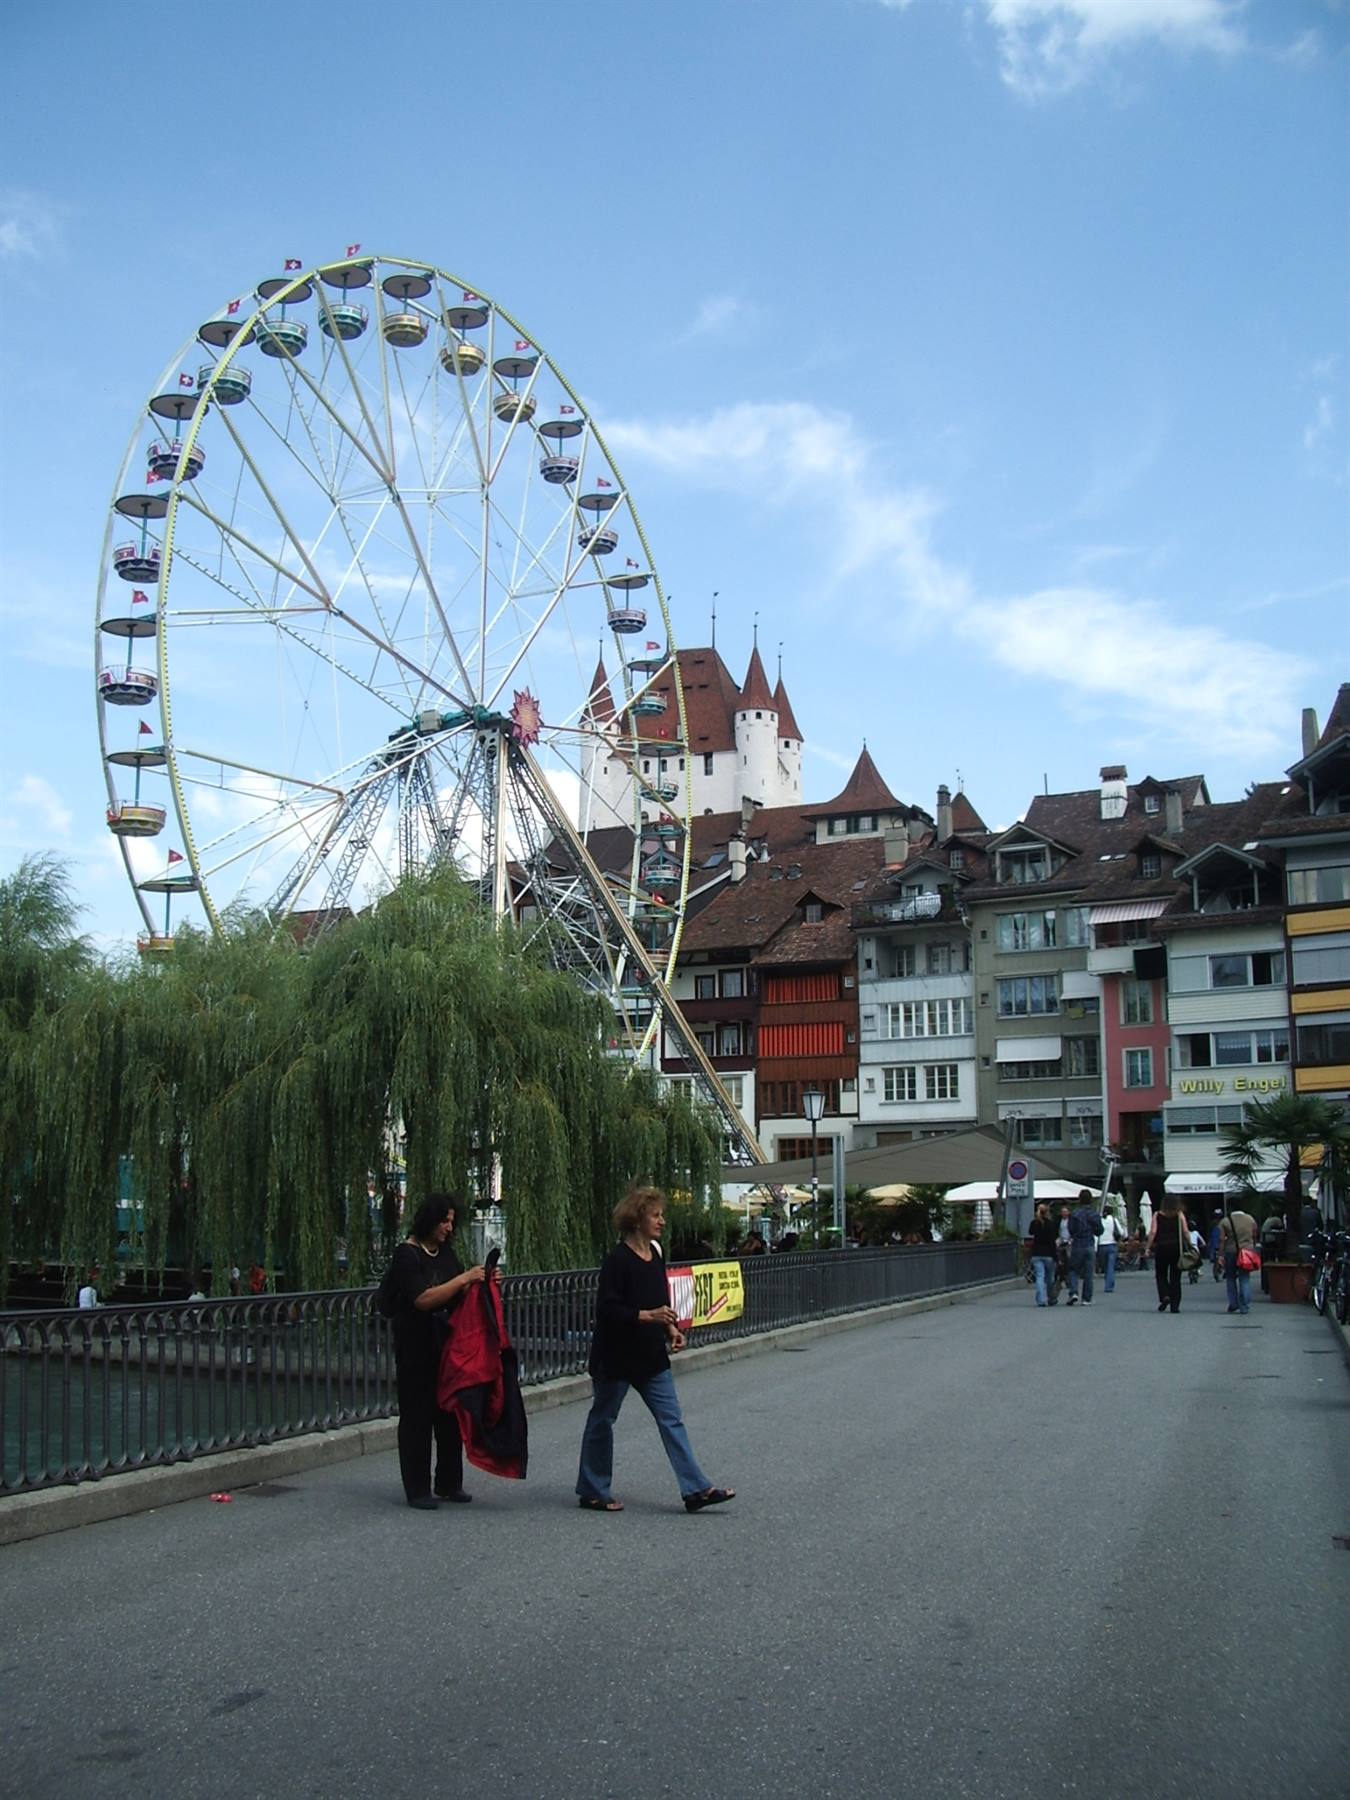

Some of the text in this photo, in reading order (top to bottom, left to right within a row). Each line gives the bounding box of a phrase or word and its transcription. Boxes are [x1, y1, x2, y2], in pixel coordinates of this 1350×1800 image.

[1180, 1076, 1286, 1095] Willy Engel
[695, 1272, 714, 1318] FEST
